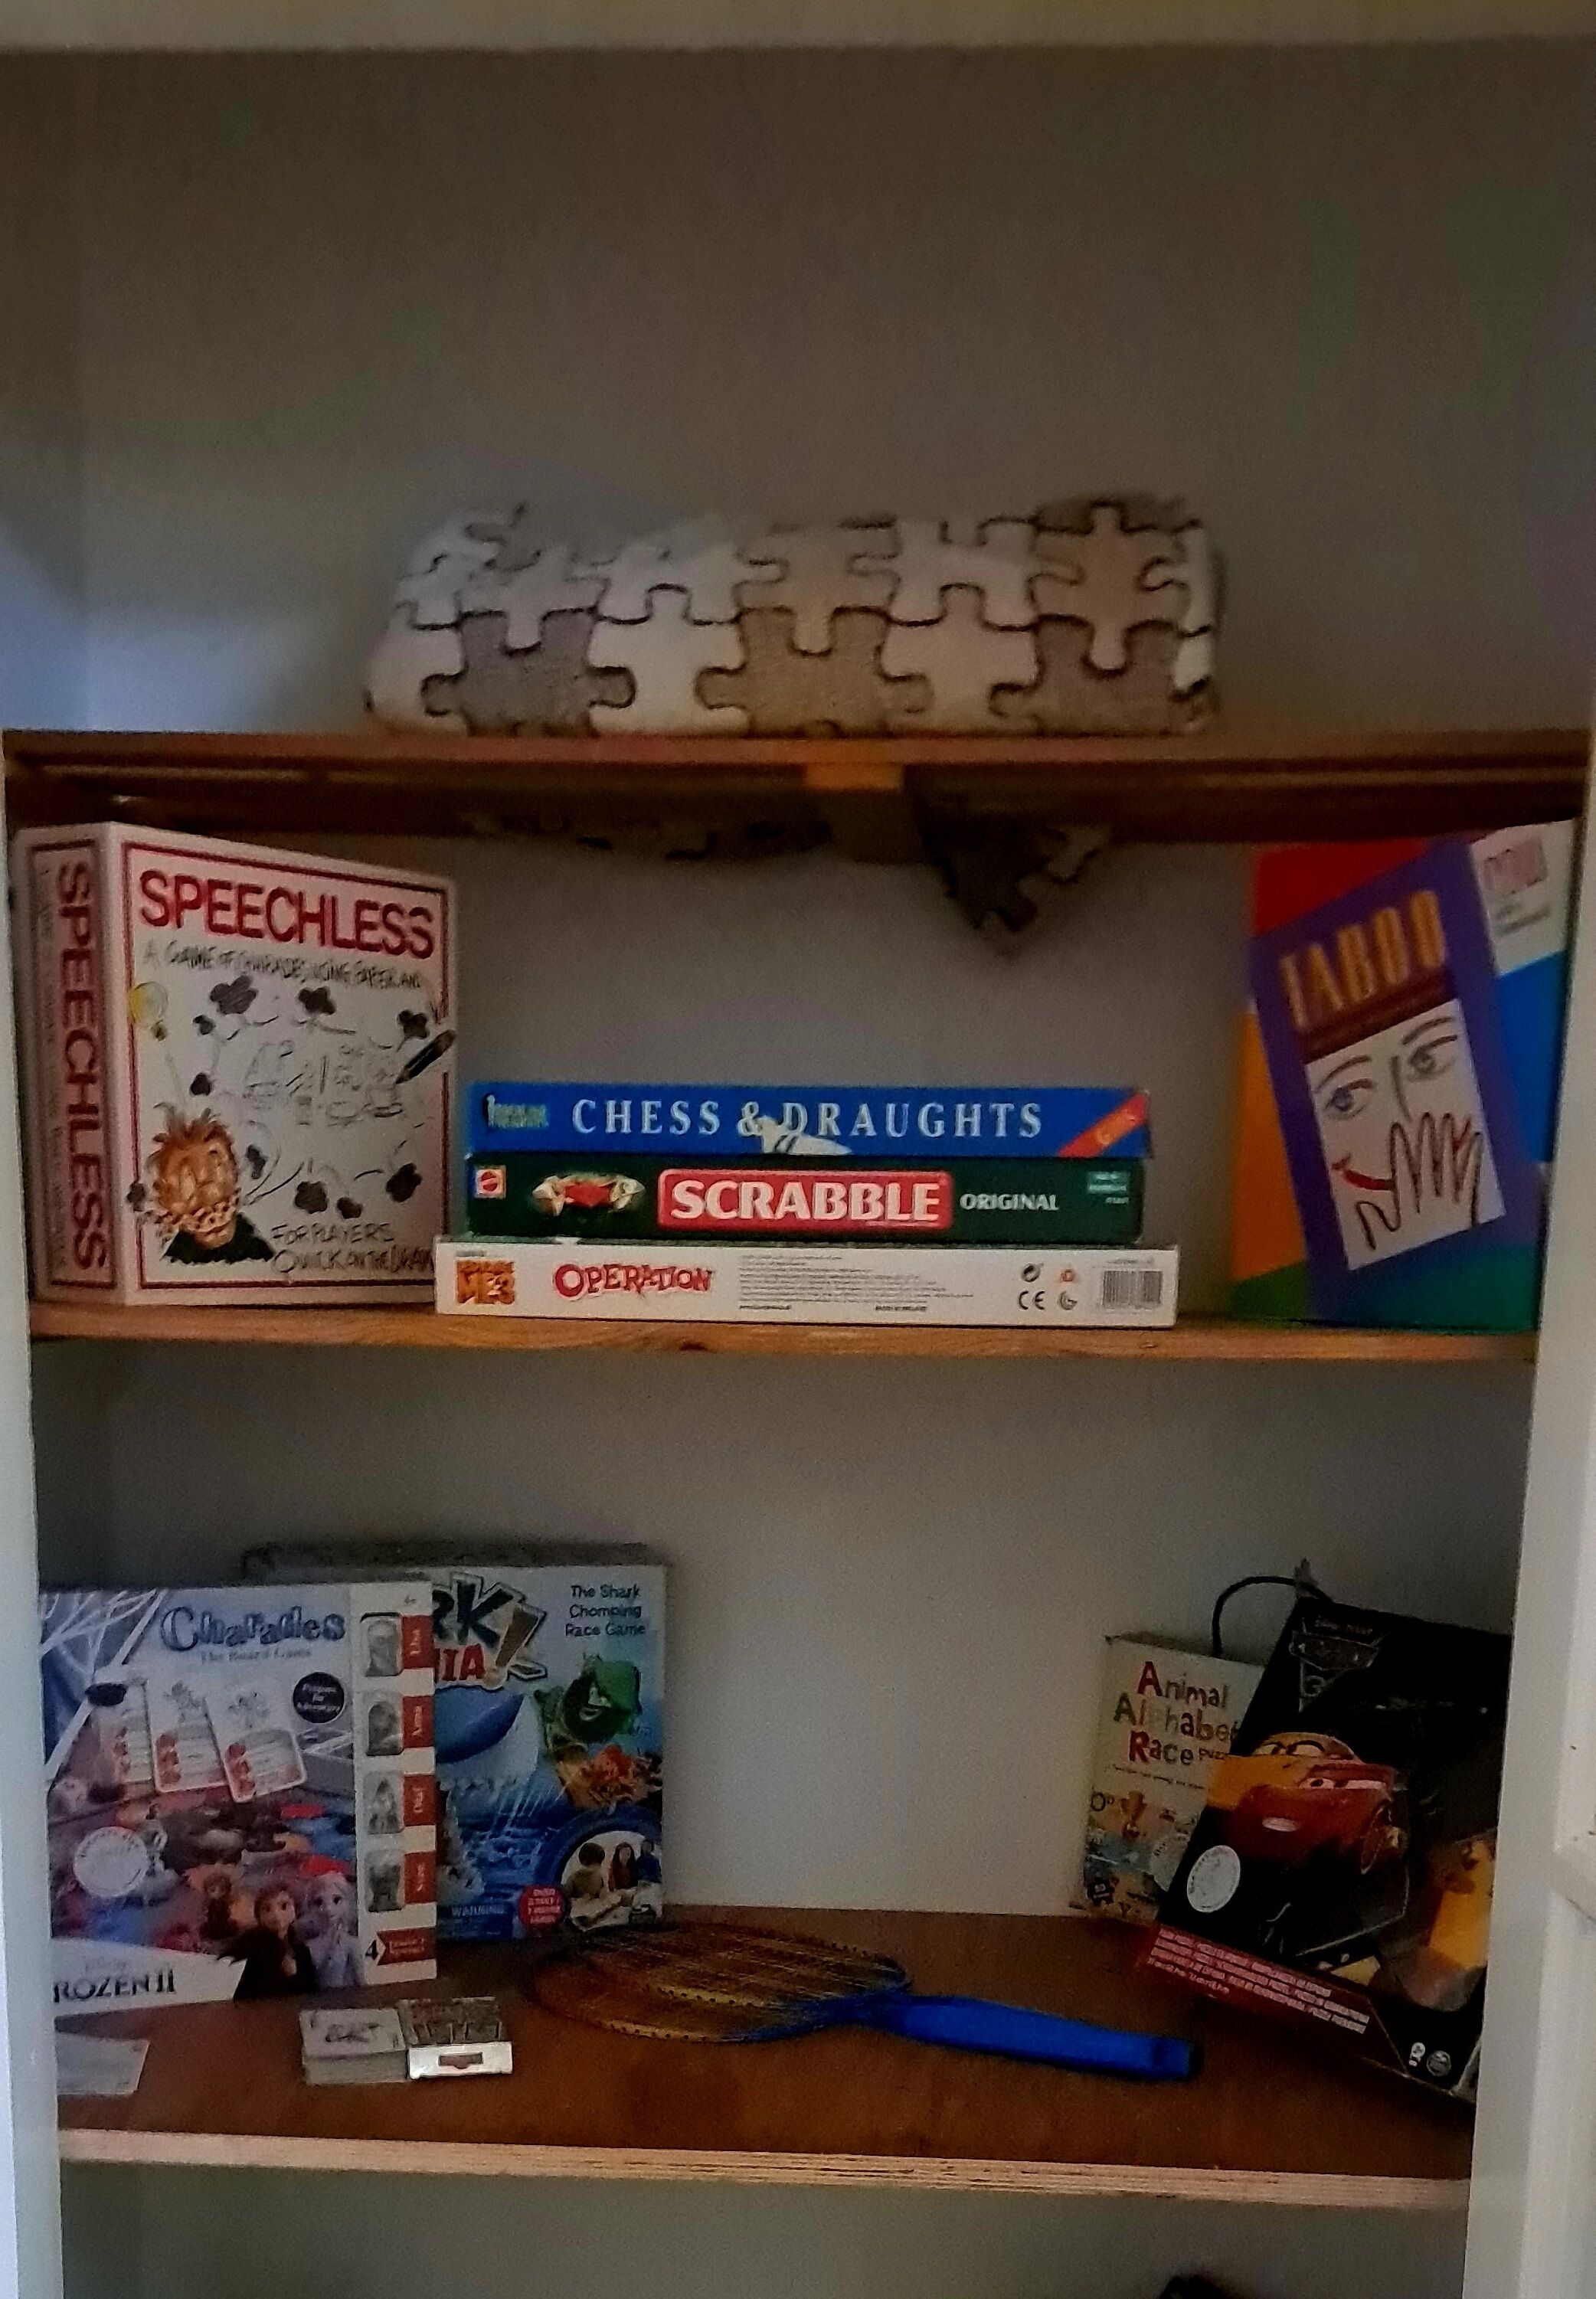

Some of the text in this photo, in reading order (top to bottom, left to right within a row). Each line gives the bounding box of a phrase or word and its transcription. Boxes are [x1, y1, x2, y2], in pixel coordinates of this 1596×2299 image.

[139, 870, 434, 959] SPEECHLESS
[58, 861, 107, 1270] SPEECHLESS
[572, 1099, 721, 1135] CHESS
[736, 1100, 760, 1137] &
[782, 1102, 1042, 1138] DRAUGHTS
[671, 1180, 1060, 1221] SCRABBLE ORIGINAL
[554, 1264, 715, 1298] OPERATION
[570, 1583, 640, 1598] The Shark
[160, 1606, 346, 1652] Charades
[565, 1621, 646, 1637] Race Game
[1137, 1660, 1228, 1709] Animal
[1113, 1692, 1241, 1741] Alhabet
[1129, 1730, 1194, 1765] Race
[365, 1939, 378, 1961] 4
[54, 1974, 150, 2003] ROZEN
